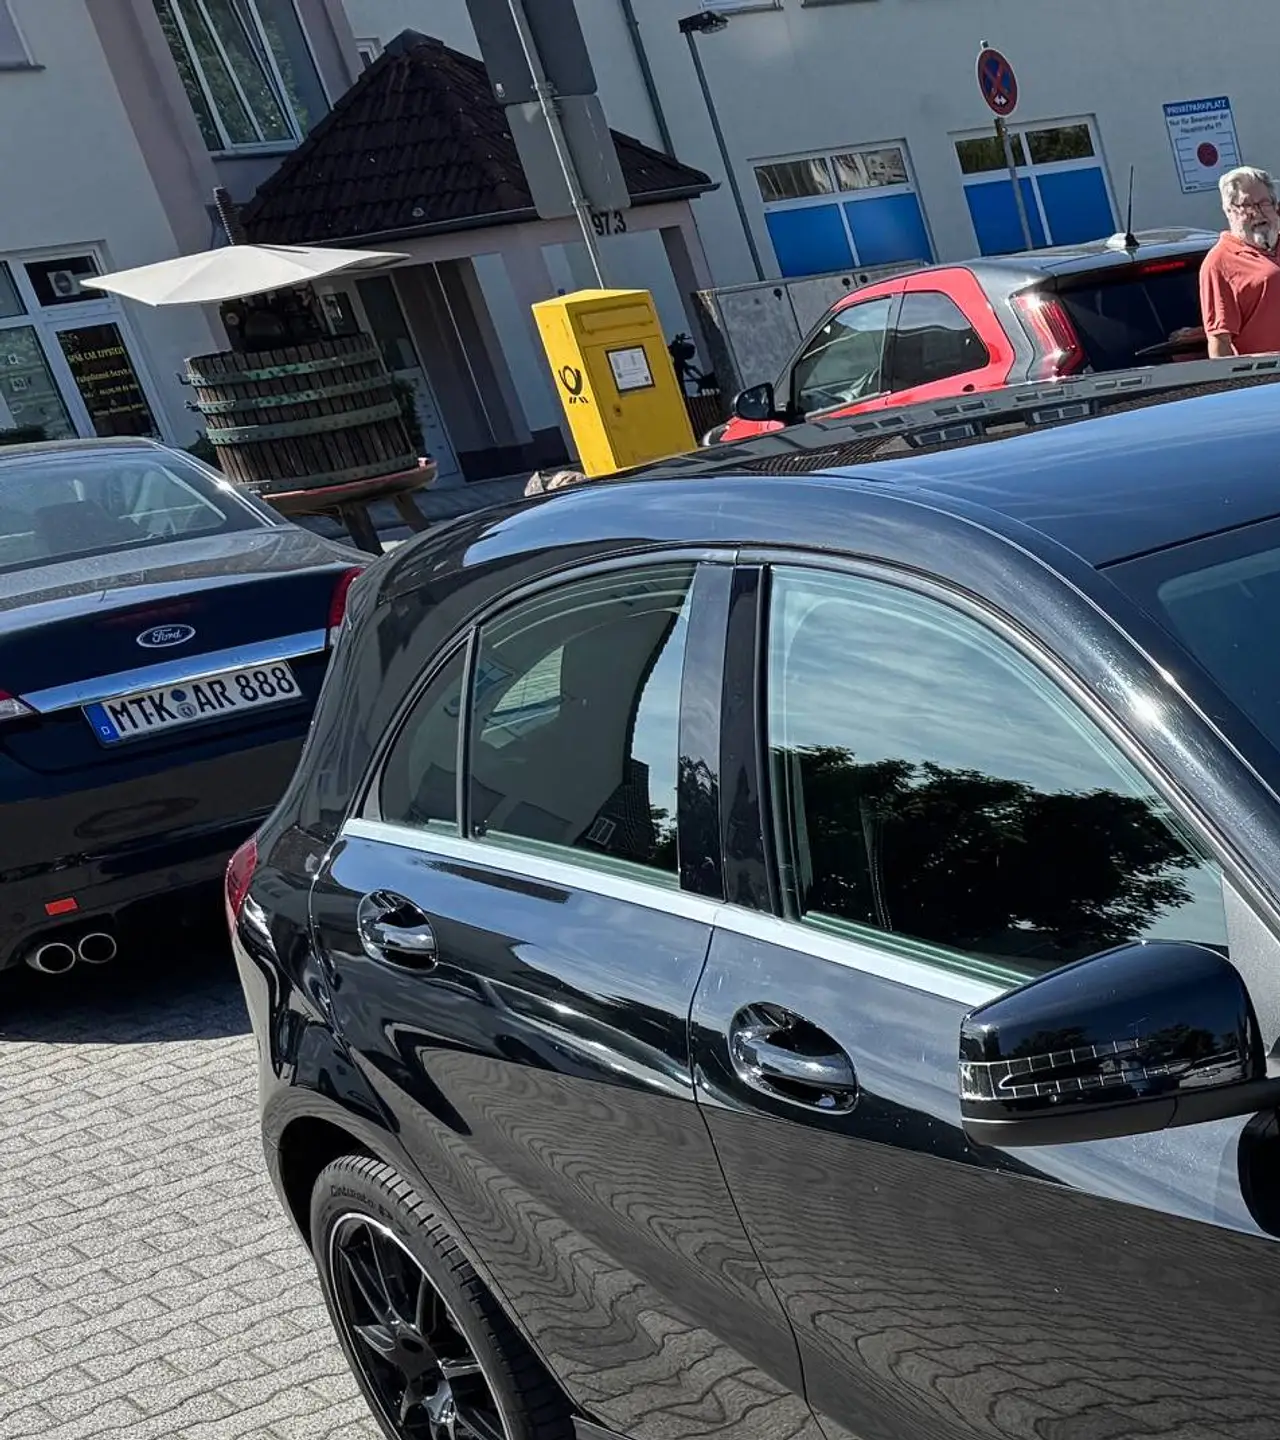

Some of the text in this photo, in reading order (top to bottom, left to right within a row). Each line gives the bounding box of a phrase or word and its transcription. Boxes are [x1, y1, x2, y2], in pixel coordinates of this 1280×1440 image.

[591, 211, 627, 236] 97.3
[152, 628, 183, 643] Ford
[107, 667, 295, 732] MTK AR 888
